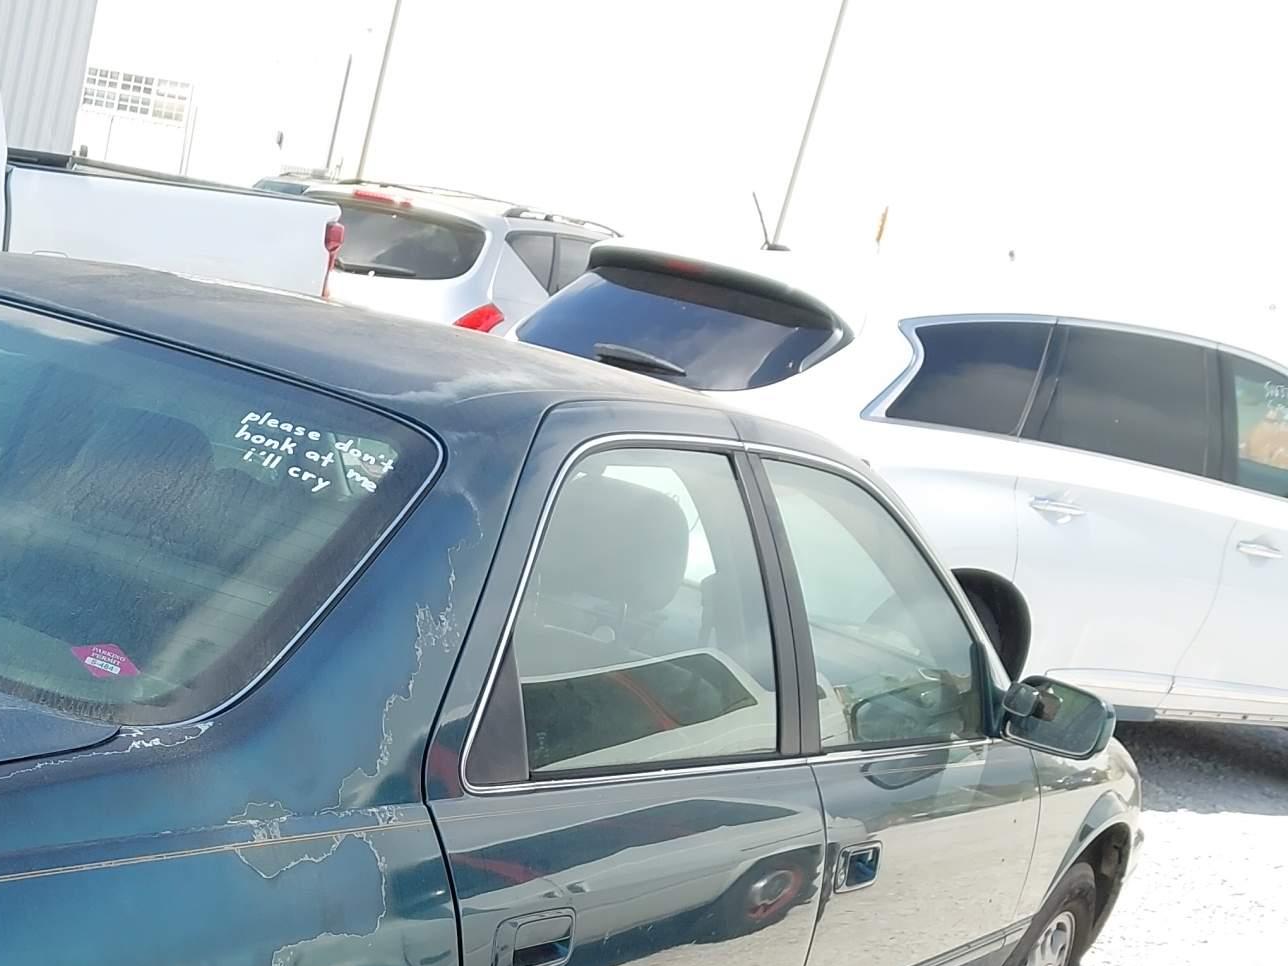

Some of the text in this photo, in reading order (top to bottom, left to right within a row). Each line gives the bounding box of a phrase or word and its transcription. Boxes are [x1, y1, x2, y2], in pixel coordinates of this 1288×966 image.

[240, 412, 395, 473] please don't
[235, 424, 377, 493] honk at me
[288, 466, 331, 492] cry
[91, 647, 126, 662] PARKING
[91, 652, 121, 666] PERMIT
